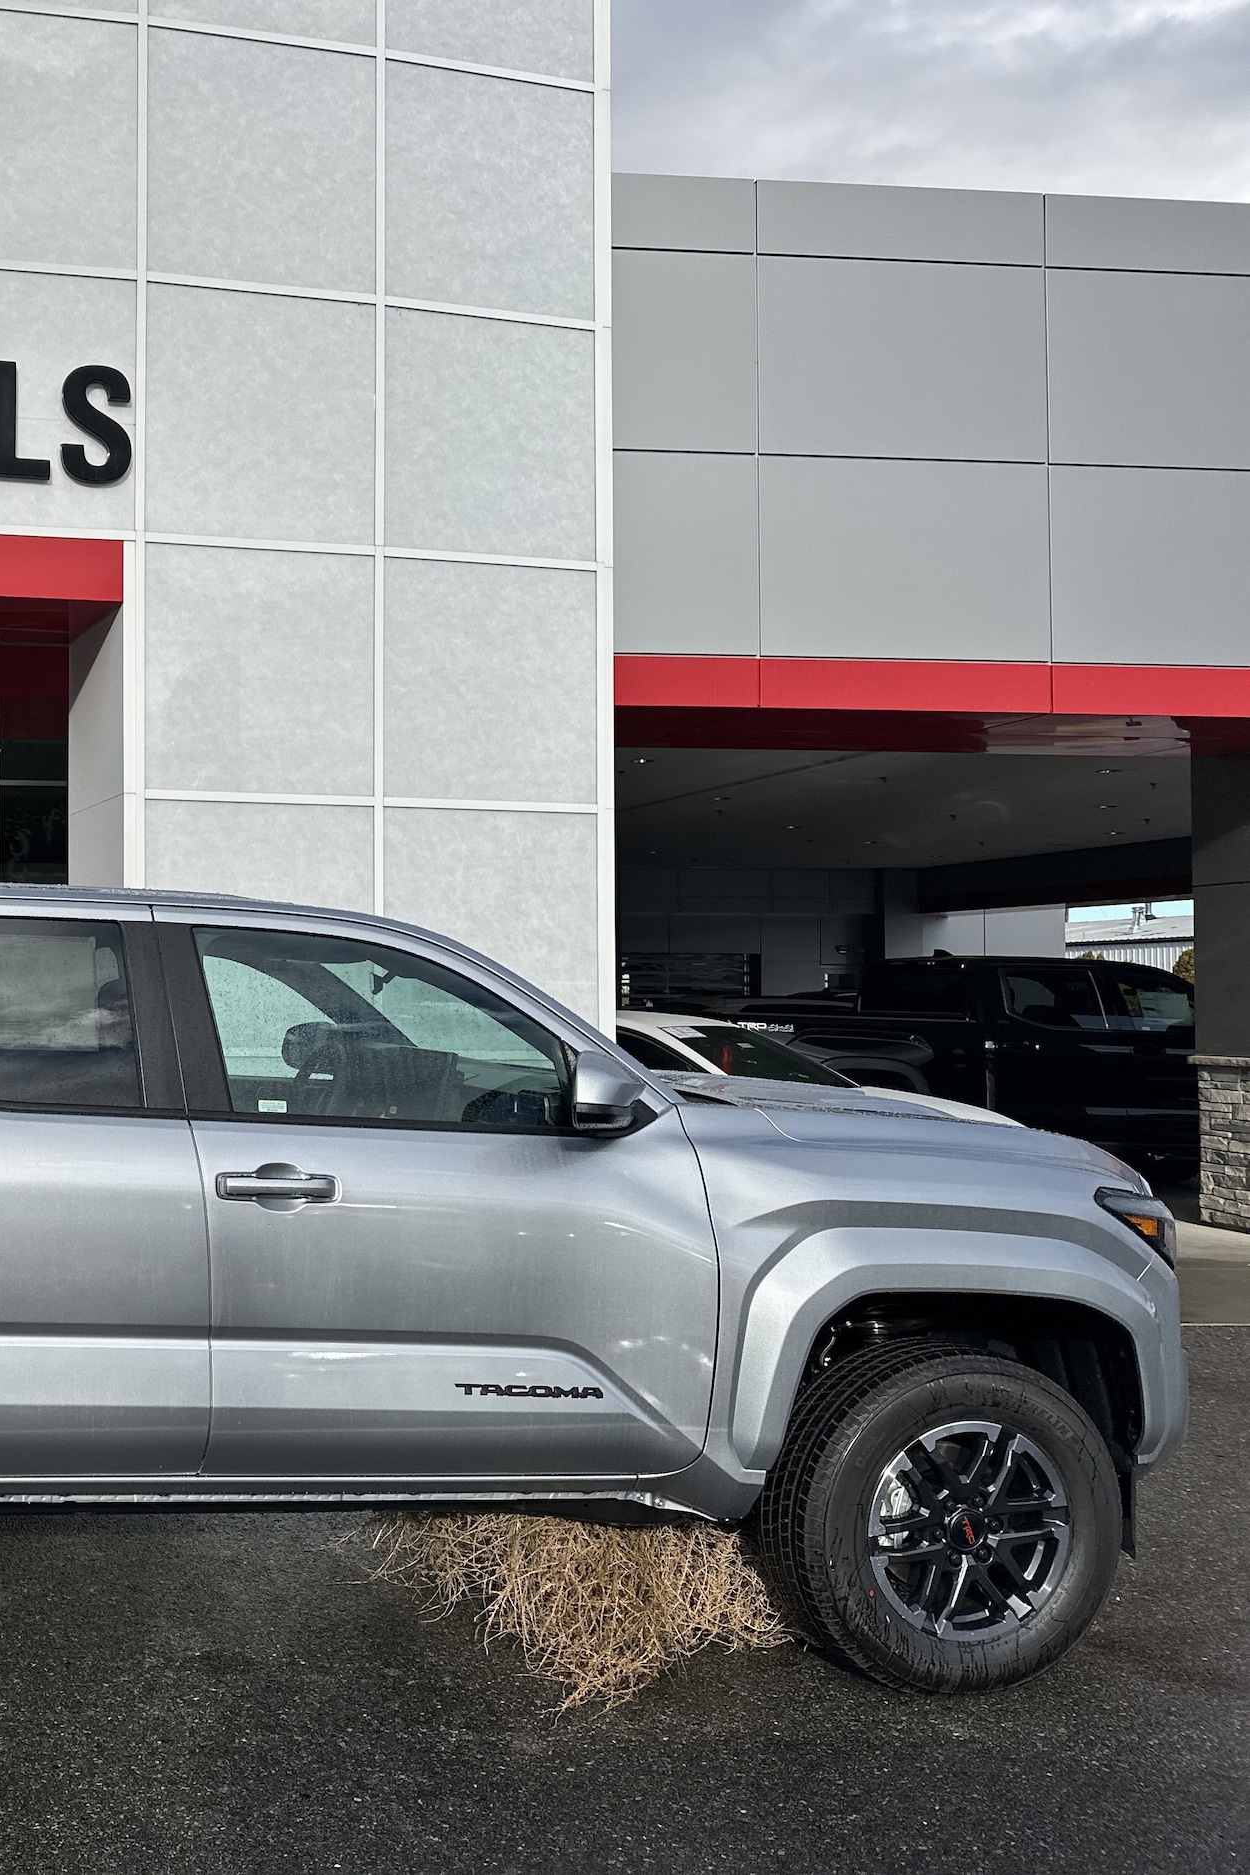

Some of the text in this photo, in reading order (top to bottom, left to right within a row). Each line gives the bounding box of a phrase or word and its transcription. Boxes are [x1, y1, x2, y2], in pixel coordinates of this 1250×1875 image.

[736, 1021, 768, 1032] TRD
[454, 1383, 604, 1399] TACOMA
[962, 1516, 976, 1545] TRD
